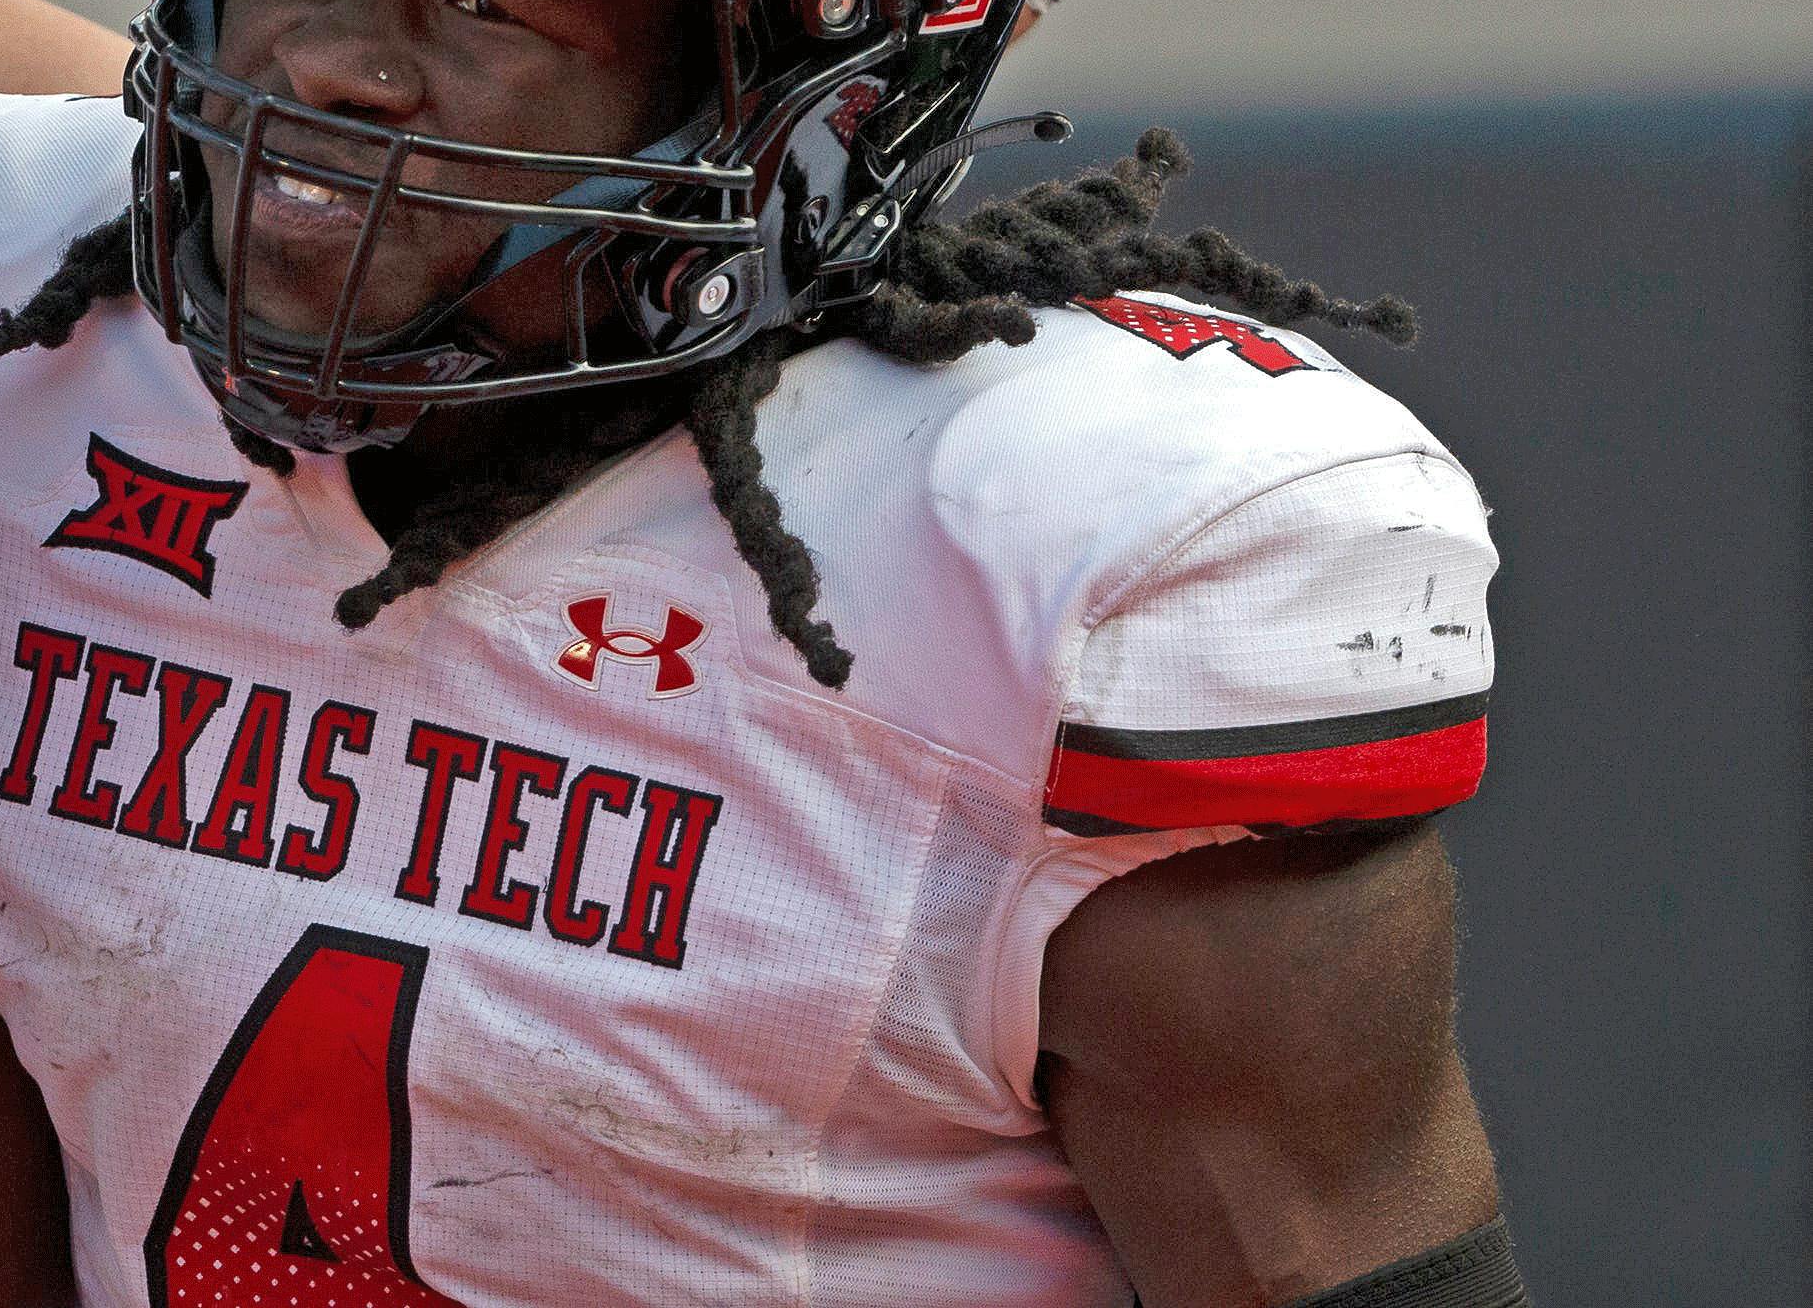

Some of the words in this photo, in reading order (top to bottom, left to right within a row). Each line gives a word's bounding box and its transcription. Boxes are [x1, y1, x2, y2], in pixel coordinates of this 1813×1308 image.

[44, 432, 248, 598] XII
[396, 718, 723, 969] TECH
[143, 923, 464, 1308] 4
